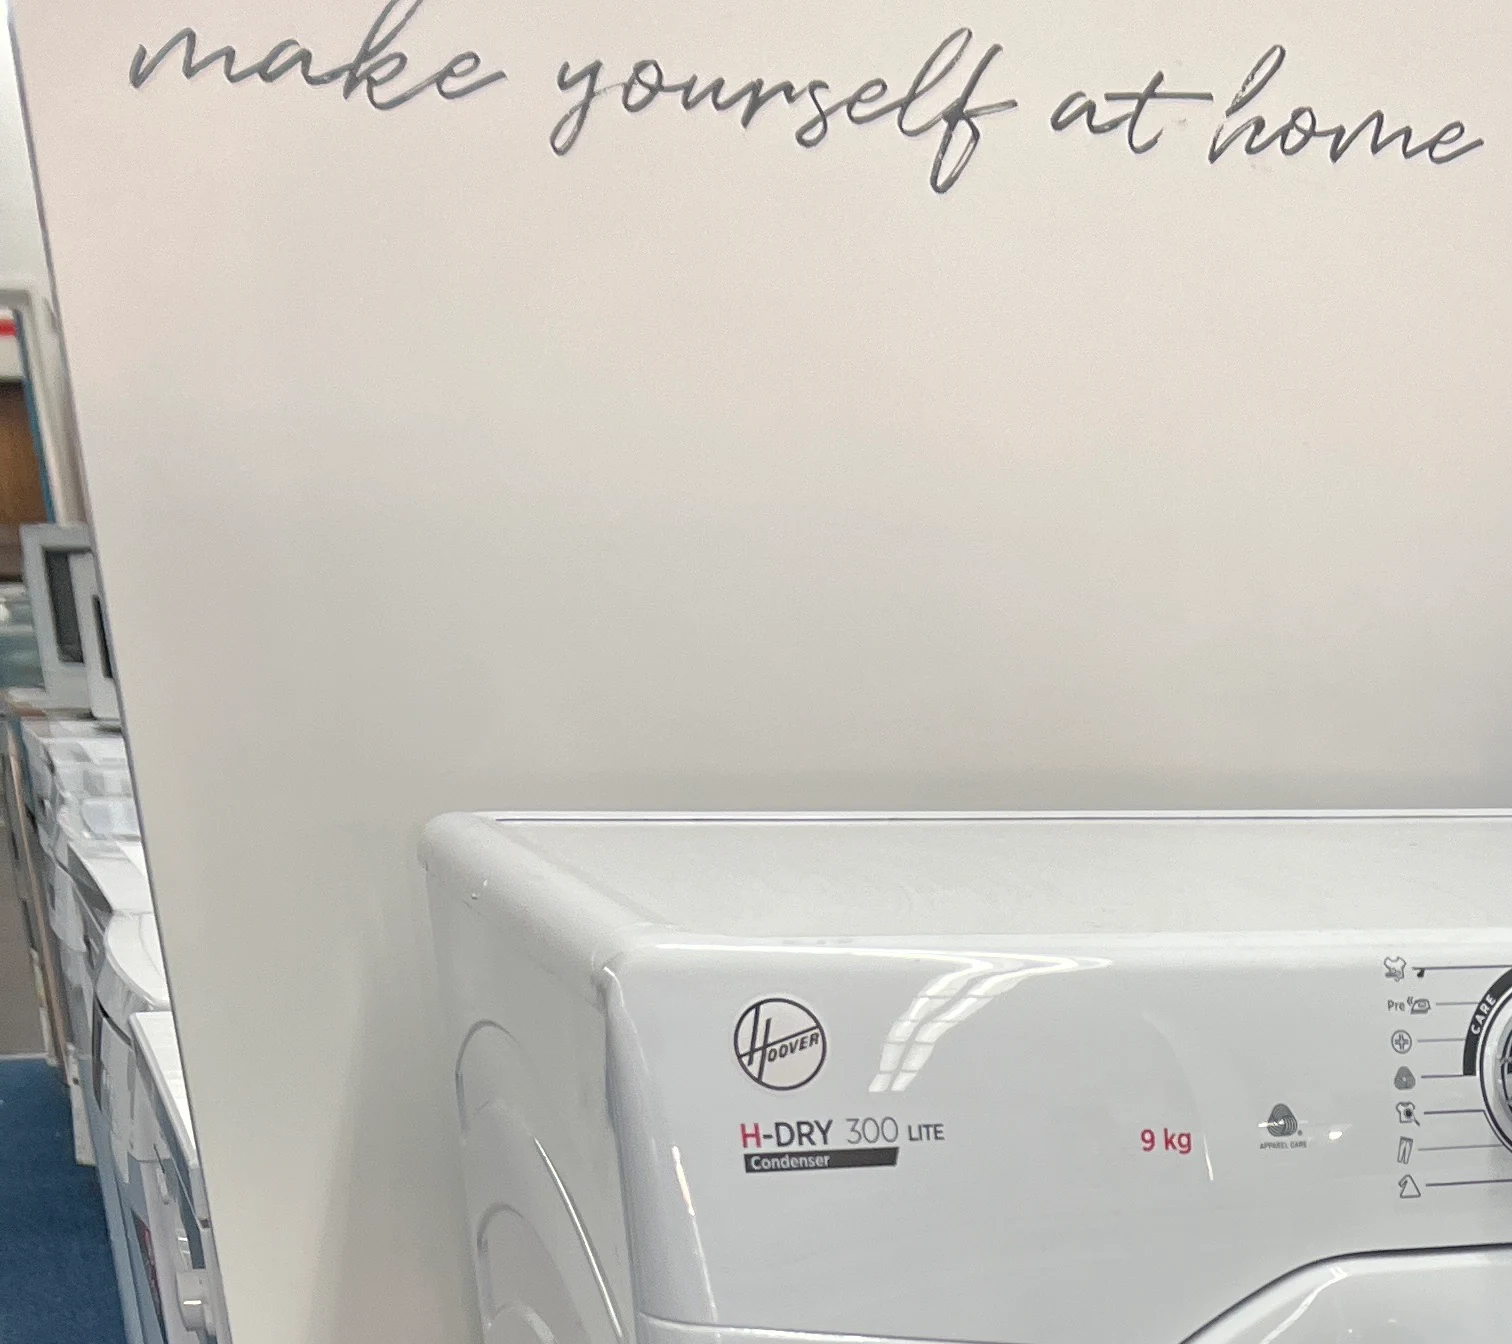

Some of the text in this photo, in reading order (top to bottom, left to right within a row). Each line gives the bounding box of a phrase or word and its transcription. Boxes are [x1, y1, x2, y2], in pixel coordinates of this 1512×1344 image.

[128, 0, 1486, 194] make yourself at home
[1387, 999, 1406, 1012] Pre
[1469, 993, 1496, 1036] CARE
[740, 1115, 945, 1149] H-DRY 300 LITE
[1140, 1126, 1193, 1155] 9 kg
[750, 1153, 831, 1171] Condenser
